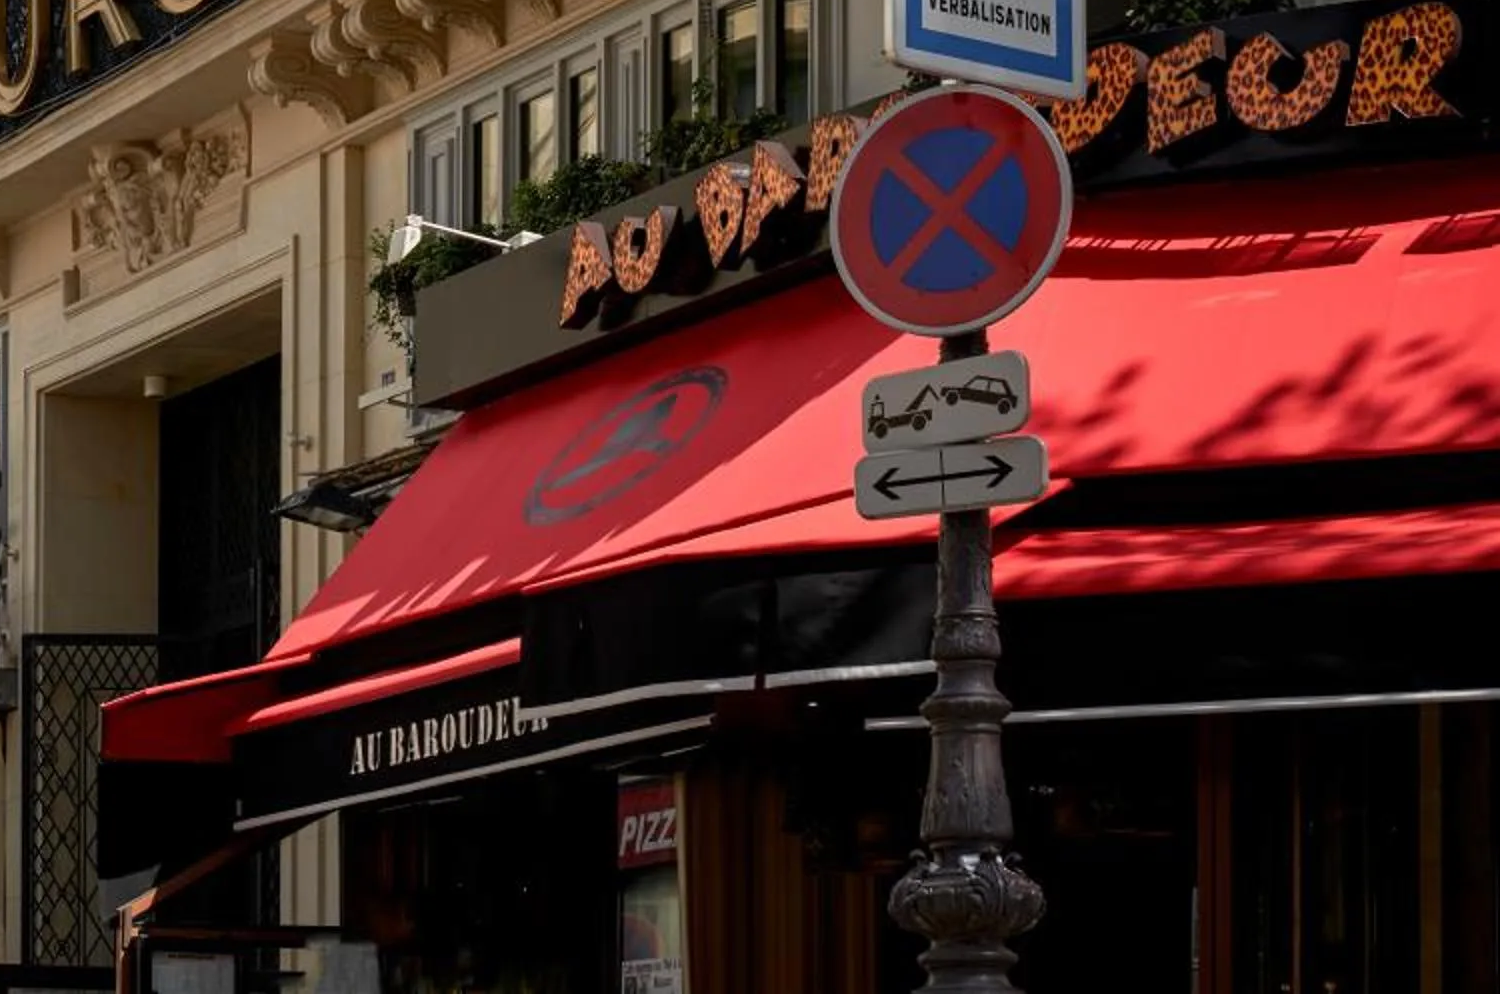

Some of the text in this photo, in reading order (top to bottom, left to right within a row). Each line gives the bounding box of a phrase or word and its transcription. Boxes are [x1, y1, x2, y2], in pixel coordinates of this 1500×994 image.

[558, 2, 1463, 328] AU BARDEUR
[350, 732, 383, 775] AU
[619, 808, 677, 856] PIZZ
